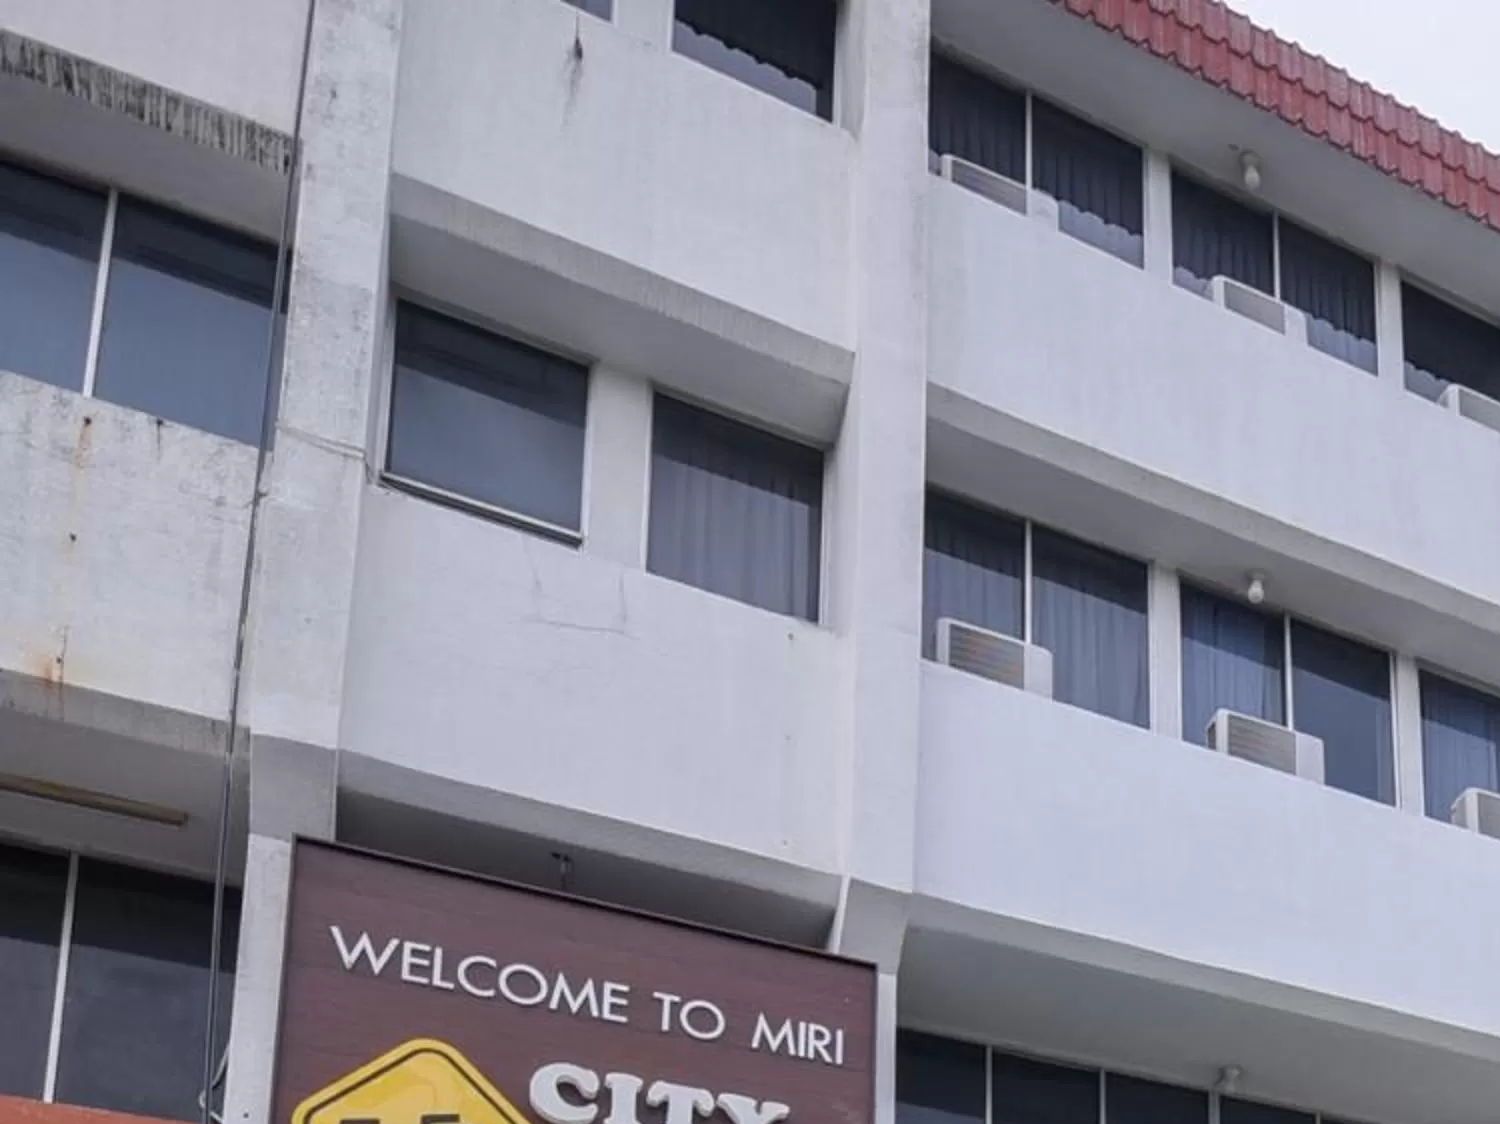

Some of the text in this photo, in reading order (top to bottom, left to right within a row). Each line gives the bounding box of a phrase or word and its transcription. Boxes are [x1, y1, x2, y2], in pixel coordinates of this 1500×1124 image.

[329, 925, 845, 1066] WELCOME TO MIRI
